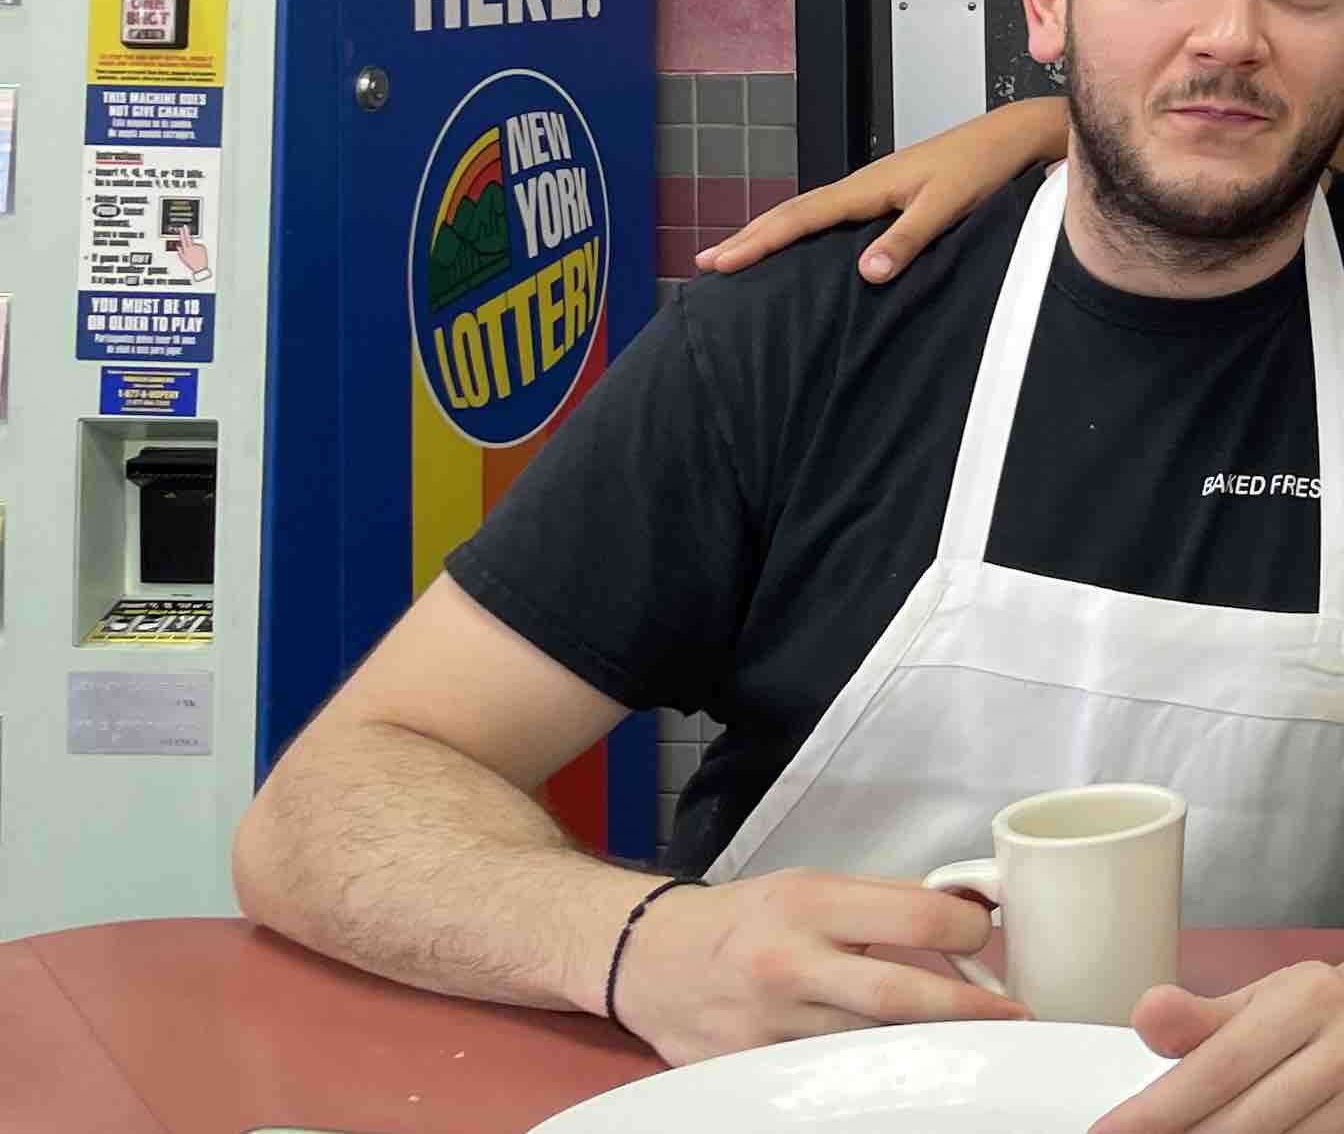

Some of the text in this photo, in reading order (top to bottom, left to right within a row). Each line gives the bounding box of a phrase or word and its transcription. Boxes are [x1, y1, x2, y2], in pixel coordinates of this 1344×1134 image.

[506, 111, 572, 176] NEW
[514, 166, 593, 259] YORK
[87, 315, 203, 333] OR OLDER TO PLAY
[91, 297, 200, 315] YOU MUST BE 18
[434, 235, 600, 409] LOTTERY
[1202, 473, 1266, 497] BAKED
[1270, 474, 1322, 498] FRES
